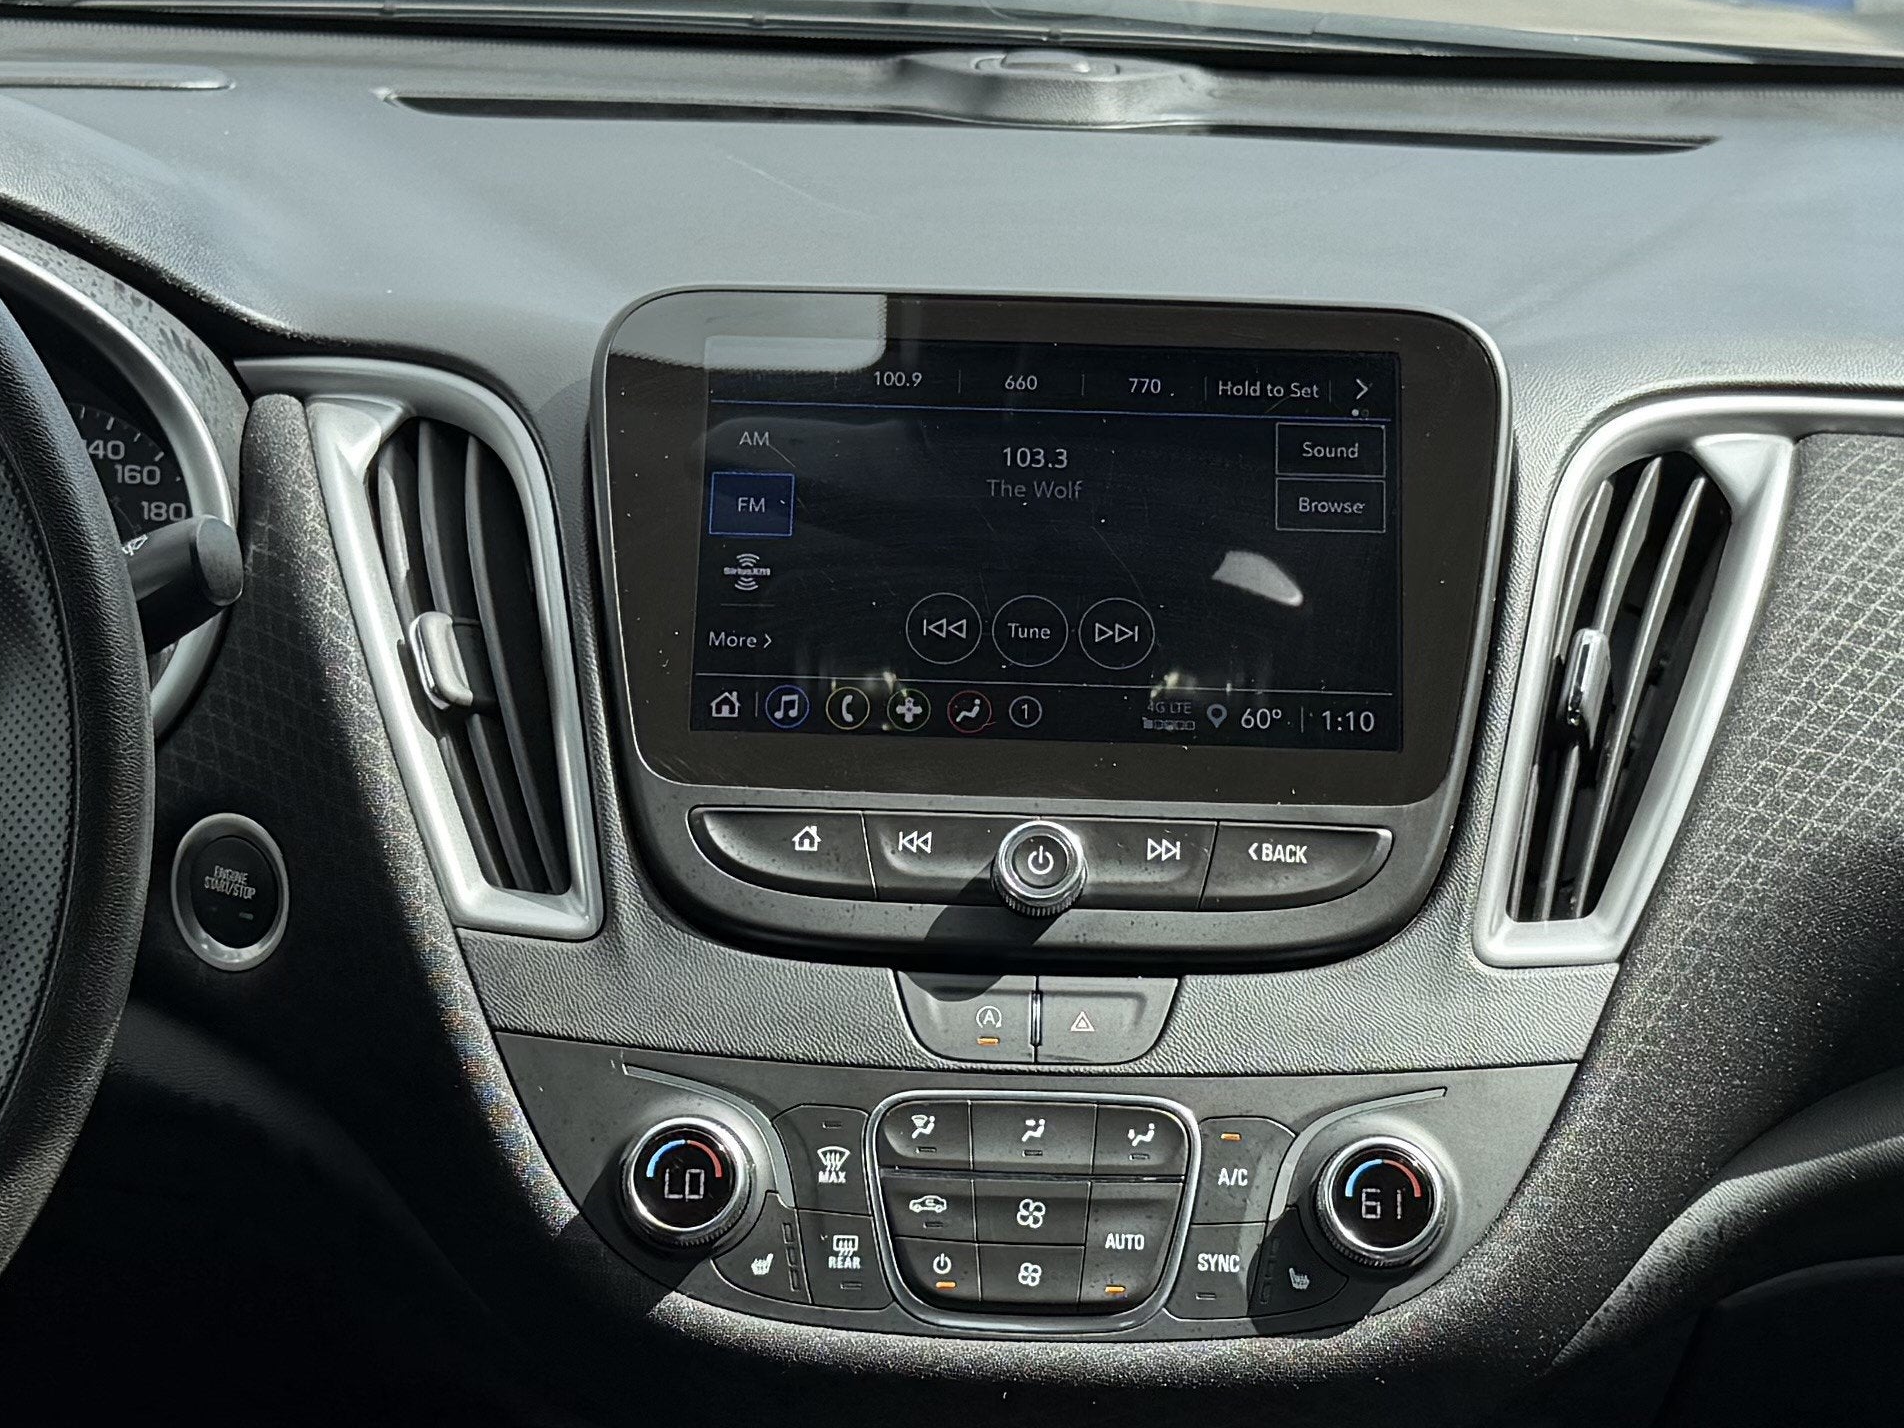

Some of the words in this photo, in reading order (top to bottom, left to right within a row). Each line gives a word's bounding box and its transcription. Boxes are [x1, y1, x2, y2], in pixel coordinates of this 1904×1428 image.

[873, 371, 923, 388] 100.9
[1004, 375, 1038, 391] 660
[1128, 378, 1162, 394] 770
[1218, 380, 1261, 398] Hold
[1266, 382, 1285, 398] to
[1290, 382, 1320, 399] Set
[739, 431, 770, 447] AM
[87, 439, 125, 460] 40
[1002, 446, 1069, 470] 103.3
[1302, 440, 1359, 460] Sound
[114, 464, 161, 486] 160
[986, 478, 1027, 499] The
[1033, 480, 1083, 500] Wolf
[140, 501, 187, 522] 180
[737, 497, 766, 513] FM
[1298, 495, 1366, 515] Browse
[708, 631, 757, 648] More
[1007, 623, 1051, 640] Tune
[1147, 701, 1166, 714] 4G
[1170, 702, 1192, 714] LTE
[1322, 711, 1376, 733] 1:10
[1262, 842, 1308, 865] BACK
[818, 1172, 846, 1184] MAX
[1217, 1168, 1248, 1186] A/C
[1361, 1188, 1403, 1220] 61
[1105, 1233, 1145, 1250] AUTO
[828, 1256, 861, 1269] REAR
[1197, 1253, 1240, 1273] SYNC
